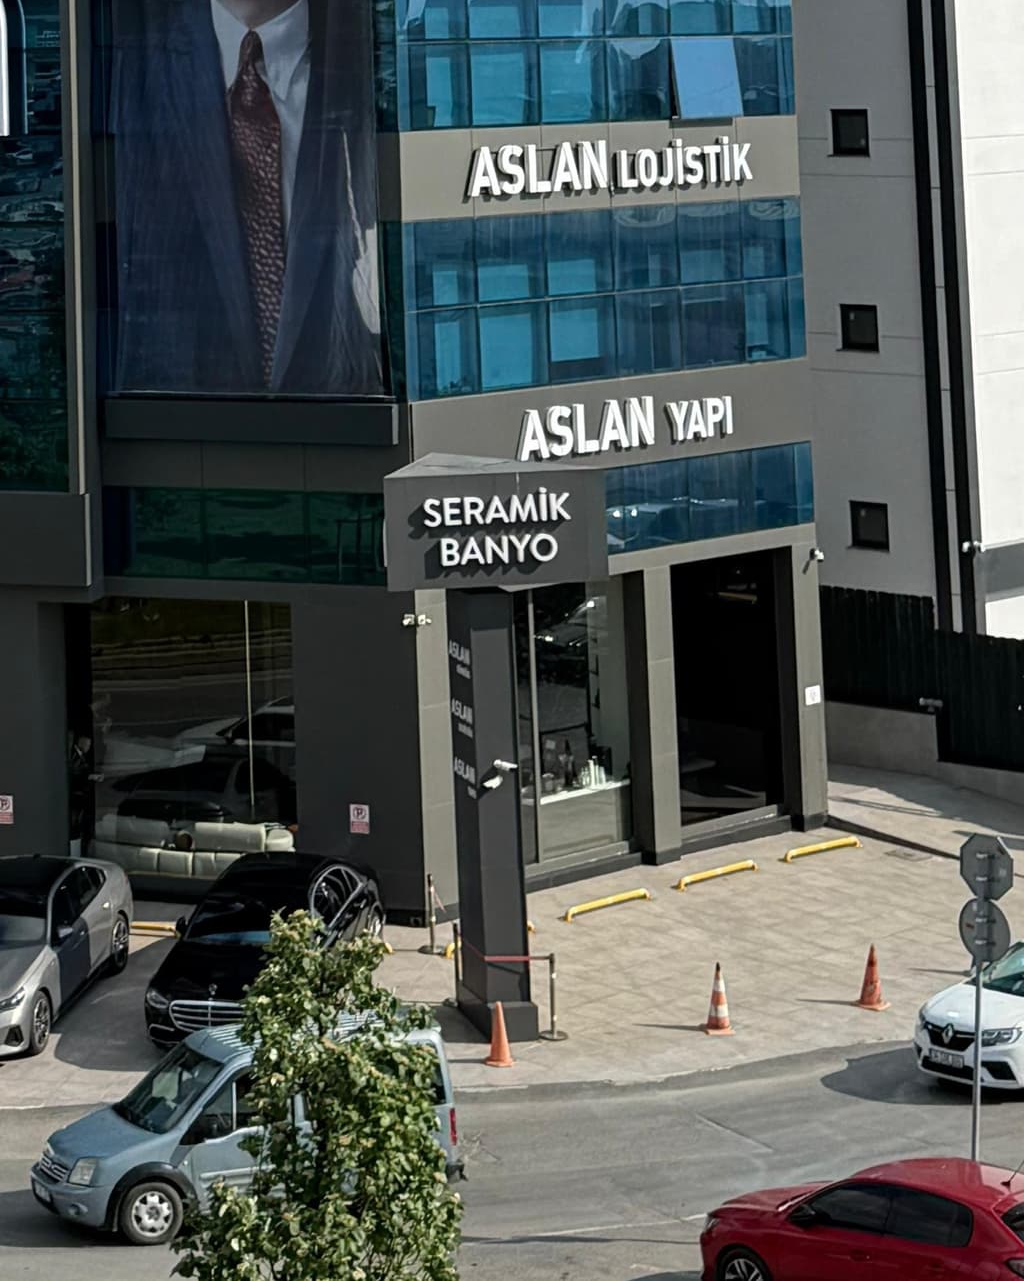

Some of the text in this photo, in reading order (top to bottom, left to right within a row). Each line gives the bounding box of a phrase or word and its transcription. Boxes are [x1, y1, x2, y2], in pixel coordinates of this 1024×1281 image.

[469, 136, 753, 197] ASLAN LOJİSTİK
[520, 396, 733, 461] ASLAN YAPI
[423, 487, 571, 528] SERAMİK
[440, 533, 558, 567] BANYO
